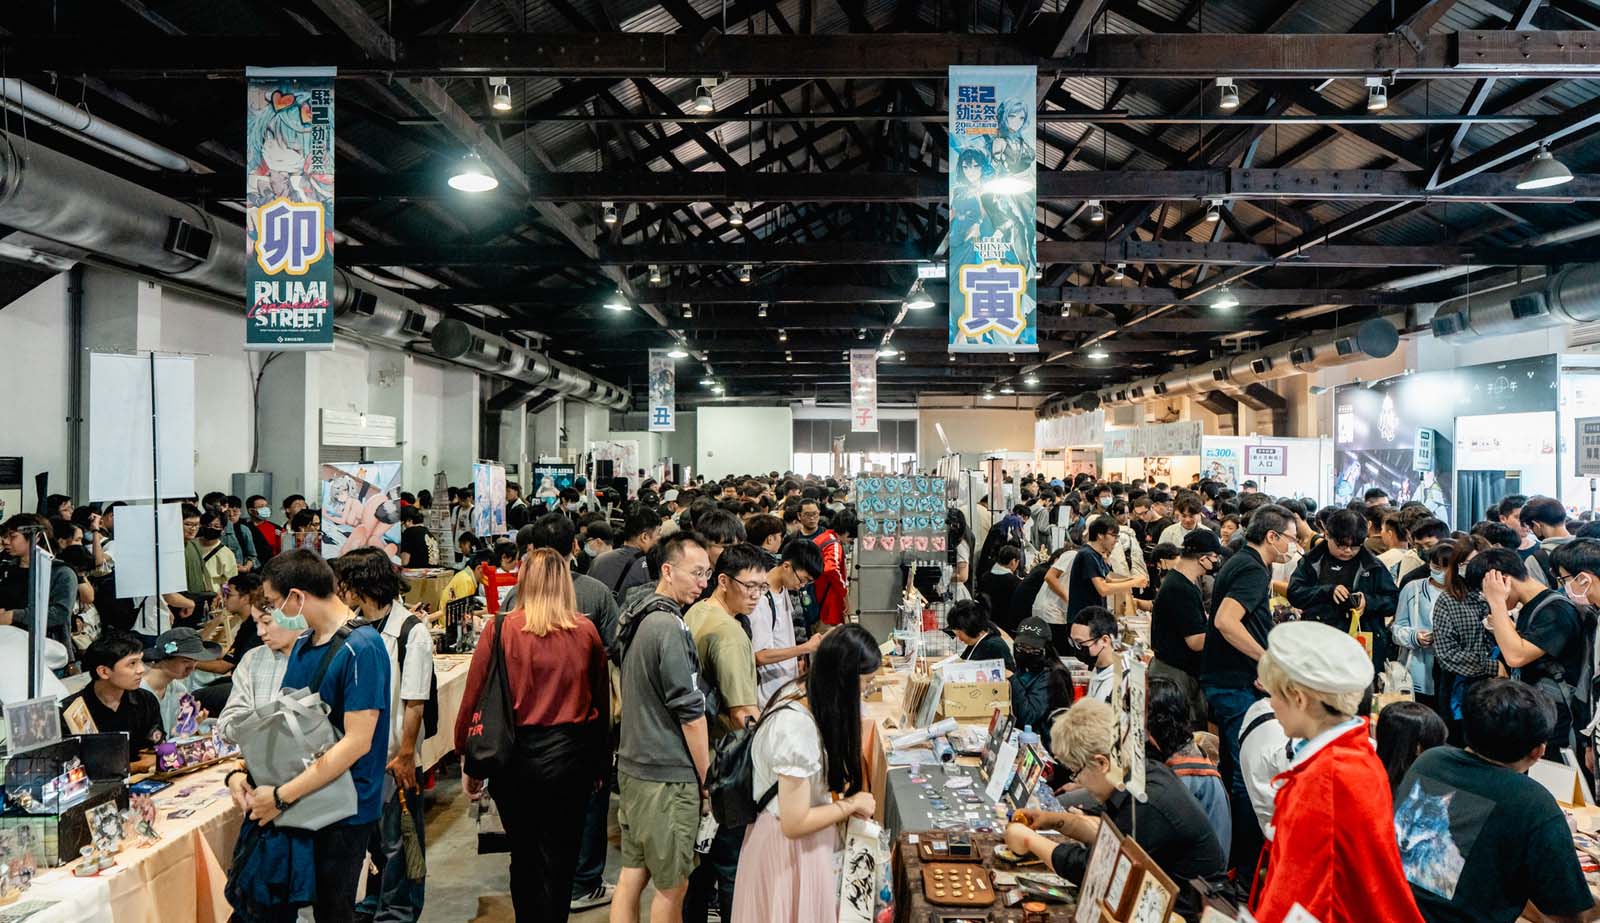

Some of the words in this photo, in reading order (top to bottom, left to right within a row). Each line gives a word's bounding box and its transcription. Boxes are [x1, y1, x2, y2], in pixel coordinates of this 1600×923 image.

[264, 205, 317, 267] 卯
[255, 280, 327, 305] RUMI
[965, 267, 1020, 330] 寅
[255, 307, 326, 329] STREET
[653, 407, 671, 425] 丑
[855, 407, 873, 426] 子
[1215, 448, 1231, 457] 300
